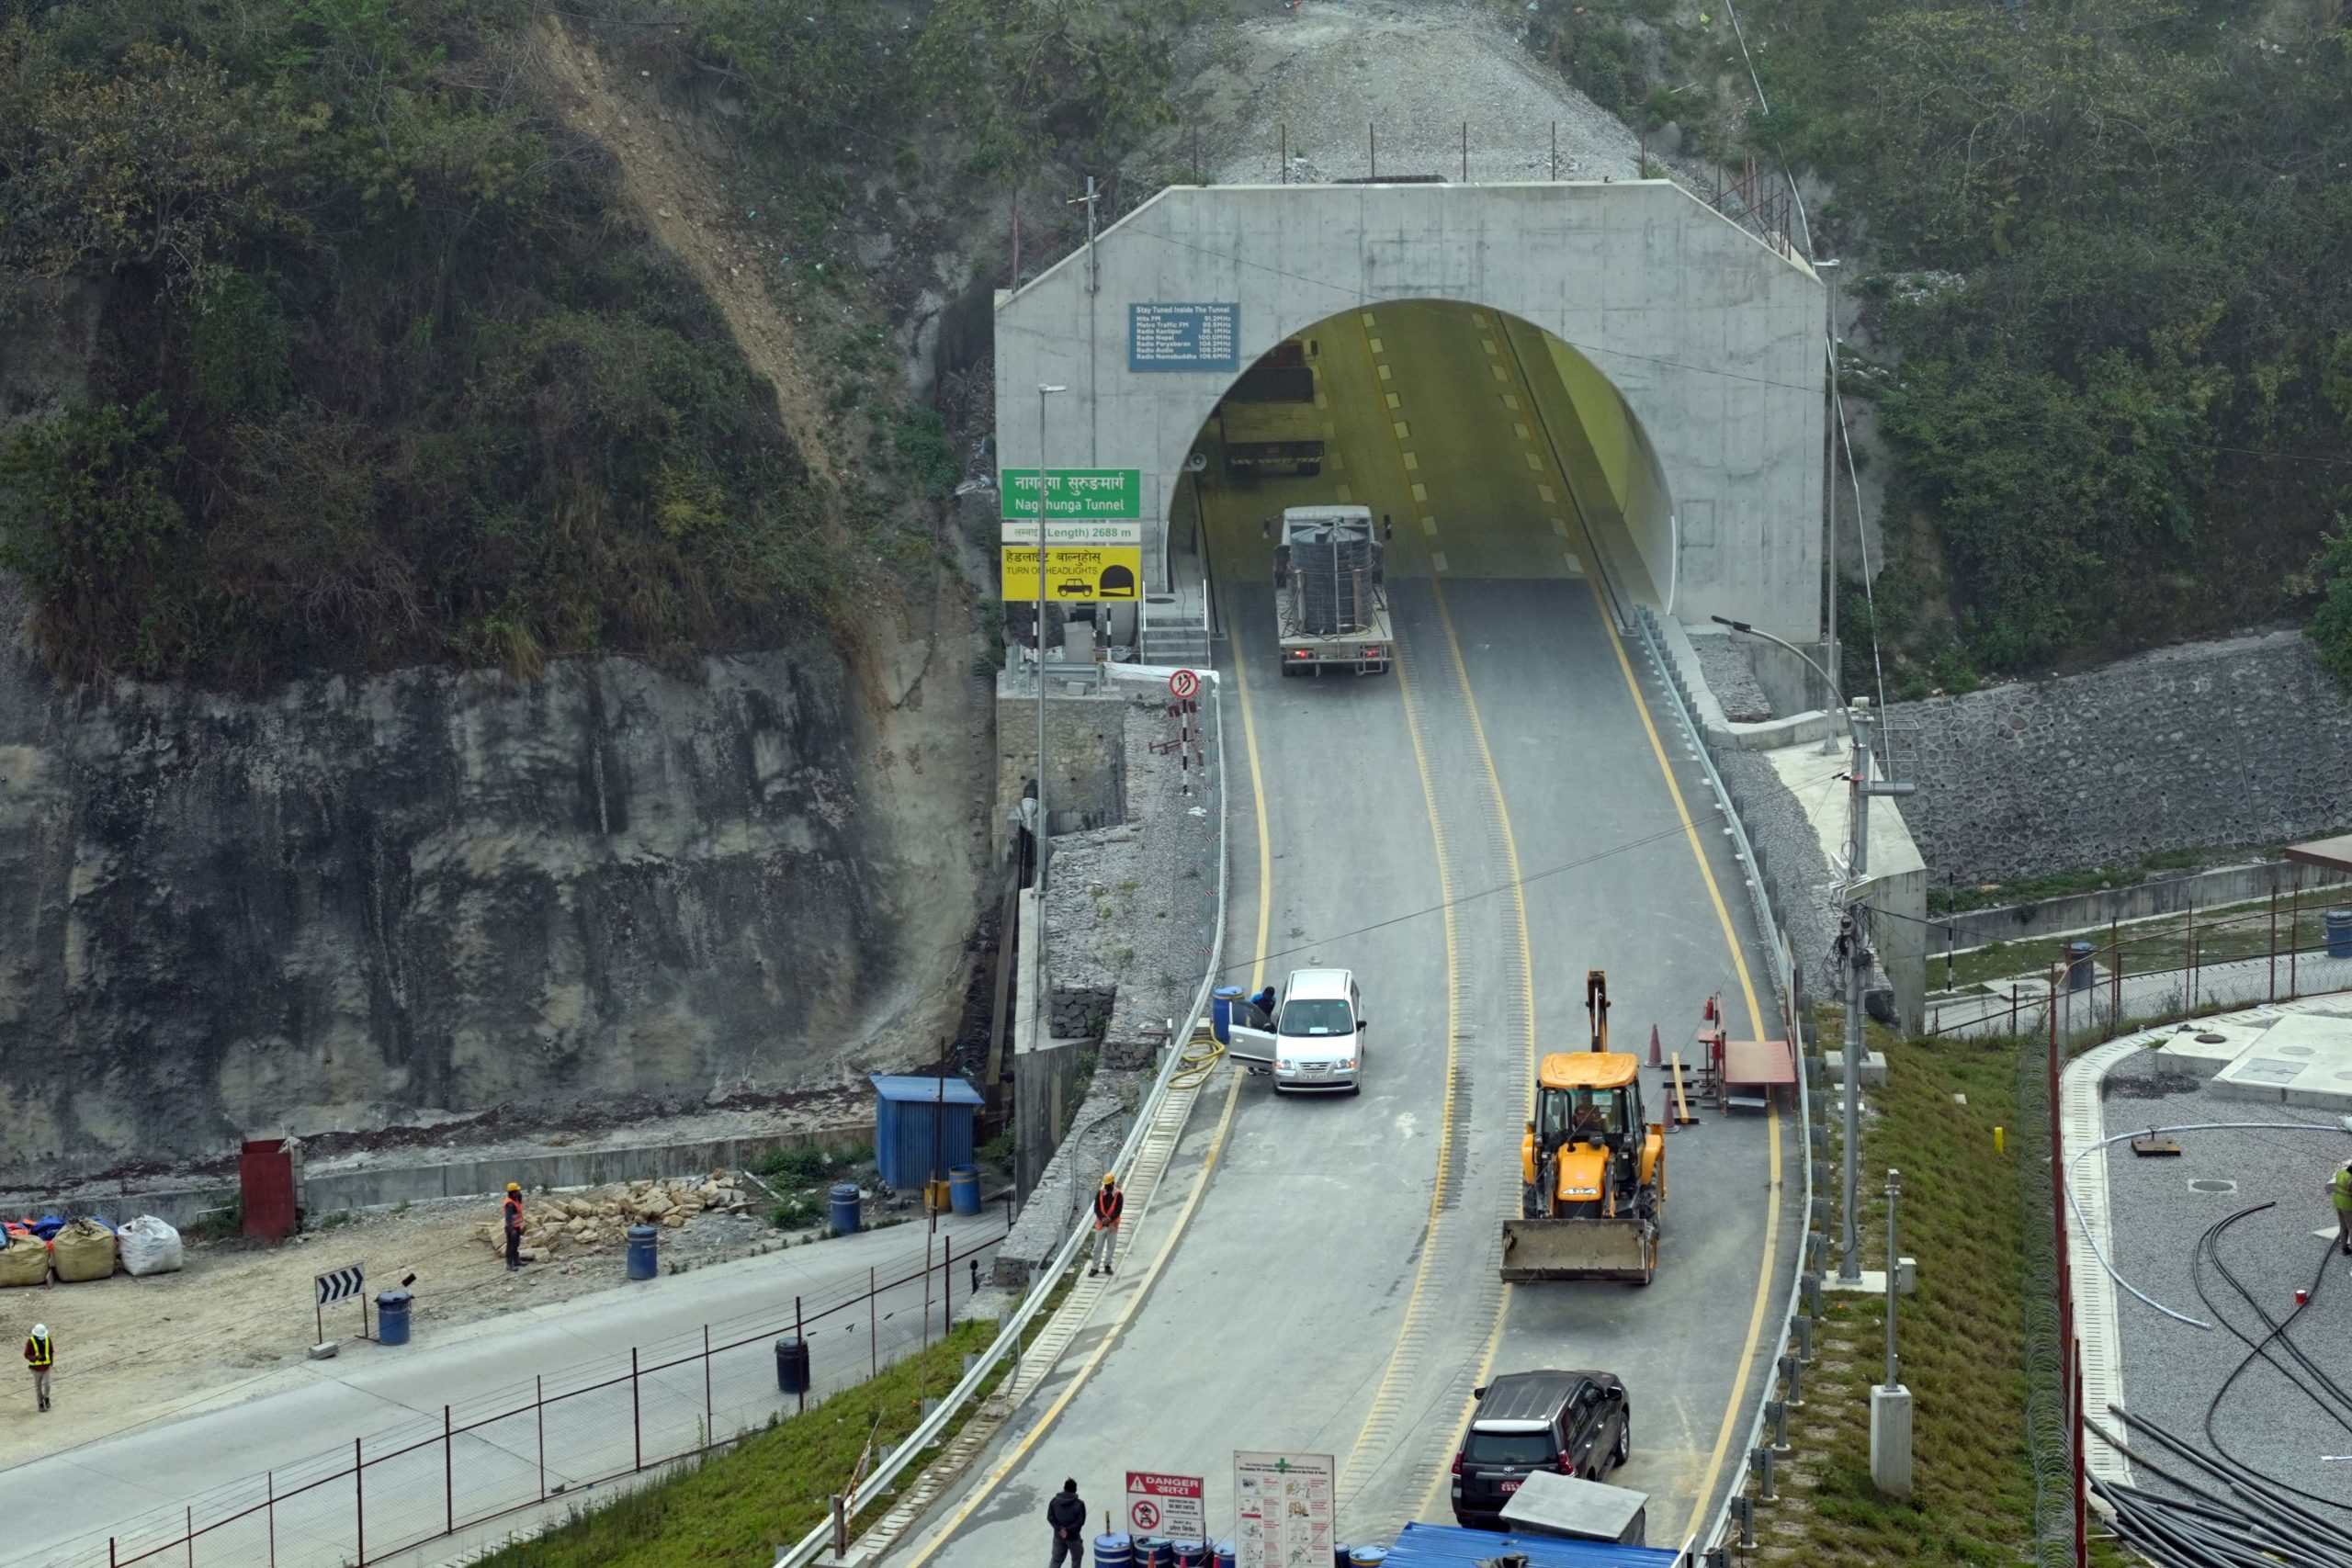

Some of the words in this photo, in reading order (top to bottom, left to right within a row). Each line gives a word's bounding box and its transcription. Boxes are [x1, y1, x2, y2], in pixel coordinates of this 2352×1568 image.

[1136, 306, 1151, 314] Stay
[1015, 499, 1081, 513] Naghunga
[1085, 498, 1125, 511] Tunnel
[1045, 526, 1090, 538] (Length)
[1092, 527, 1118, 537] 2688
[1007, 566, 1029, 575] TURN
[1046, 566, 1098, 575] HEADLIGHTS
[1146, 1476, 1199, 1488] DANGER
[1156, 1484, 1190, 1495] खतरा
